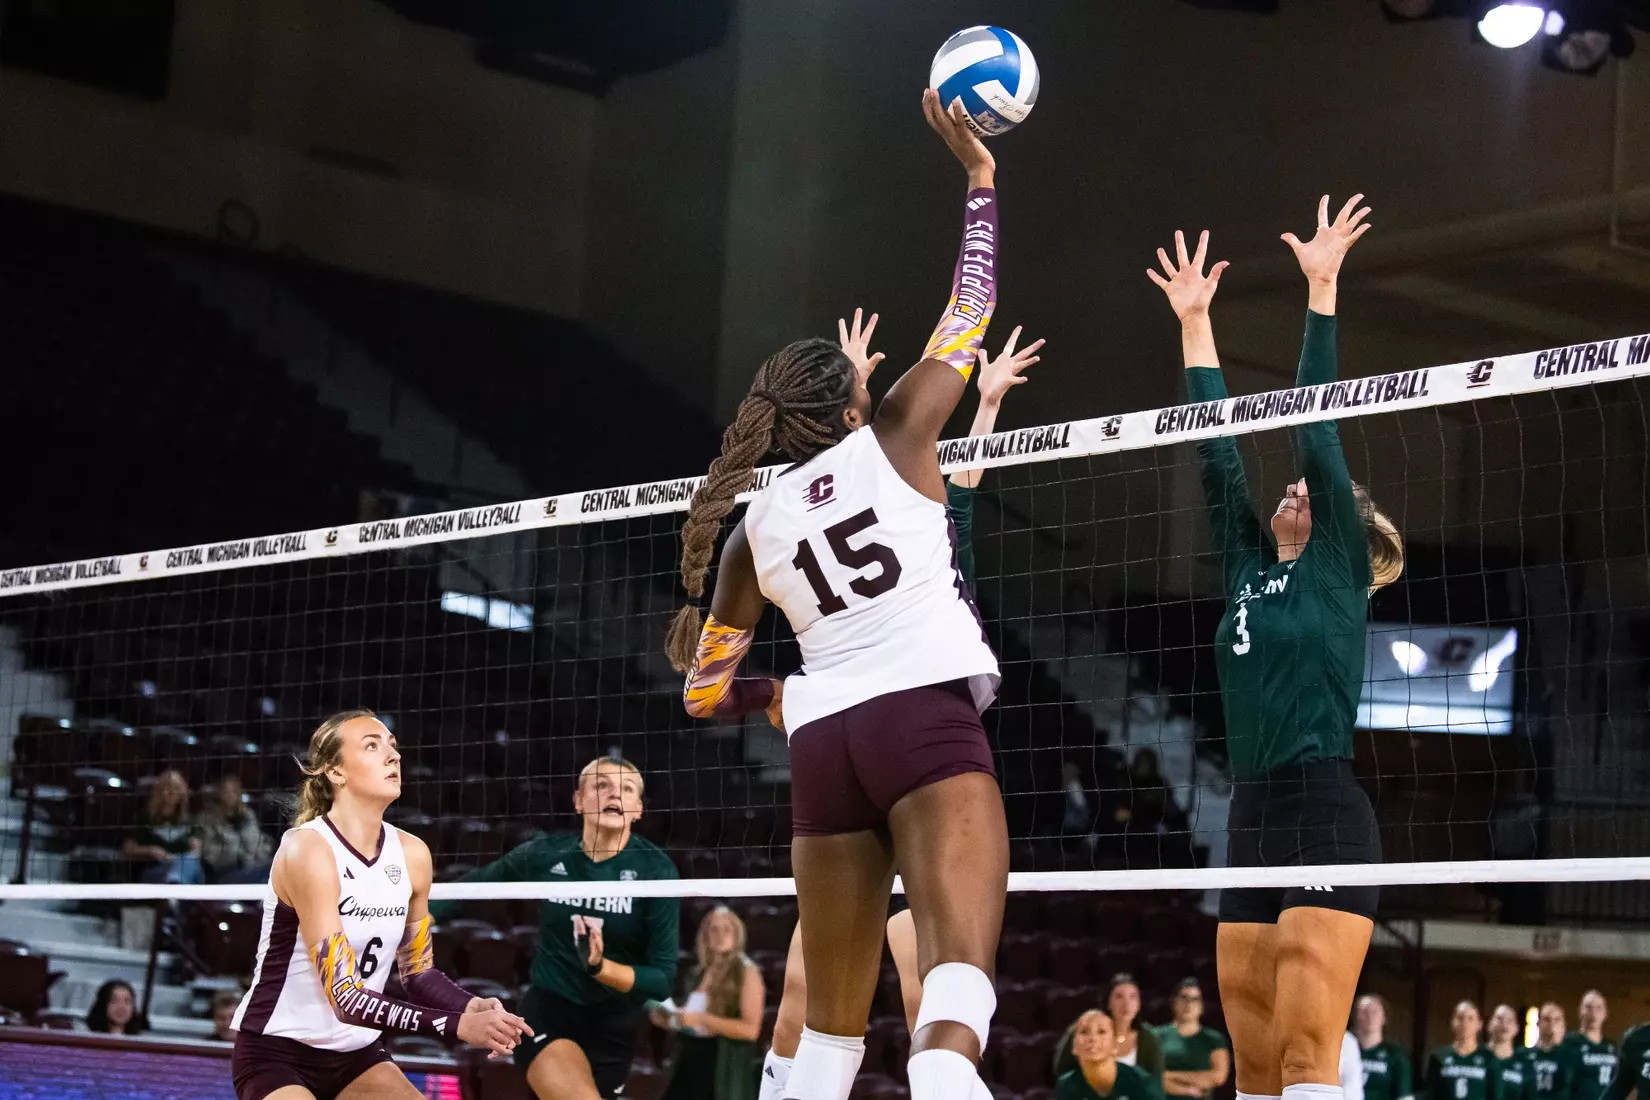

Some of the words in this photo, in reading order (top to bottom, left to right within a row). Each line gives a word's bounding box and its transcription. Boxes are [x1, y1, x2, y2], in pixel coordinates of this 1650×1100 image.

[953, 220, 994, 326] CHIPPEWAS
[1534, 340, 1619, 380] CENTRAL
[1154, 400, 1226, 435] CENTRAL
[1230, 387, 1320, 424] MICHIGAN
[1319, 369, 1429, 411] VOLLEYBALL
[938, 438, 979, 466] IGAN
[981, 424, 1071, 460] VOLLEYBALL
[581, 489, 632, 513] CENTRAL
[635, 479, 695, 505] MICHIGAN
[359, 522, 401, 543] CENTRAL
[403, 513, 456, 538] MICHIGAN
[457, 503, 522, 531] VOLLEYBALL
[75, 557, 122, 580] VOLLEYBALL
[166, 549, 203, 569] CENTRAL
[207, 540, 251, 563] MICHIGAN
[252, 533, 307, 557] VOLLEYBALL
[792, 507, 903, 617] 15
[1232, 602, 1251, 656] 3
[360, 937, 384, 979] 6
[332, 975, 423, 1032] CHIPPEWAS
